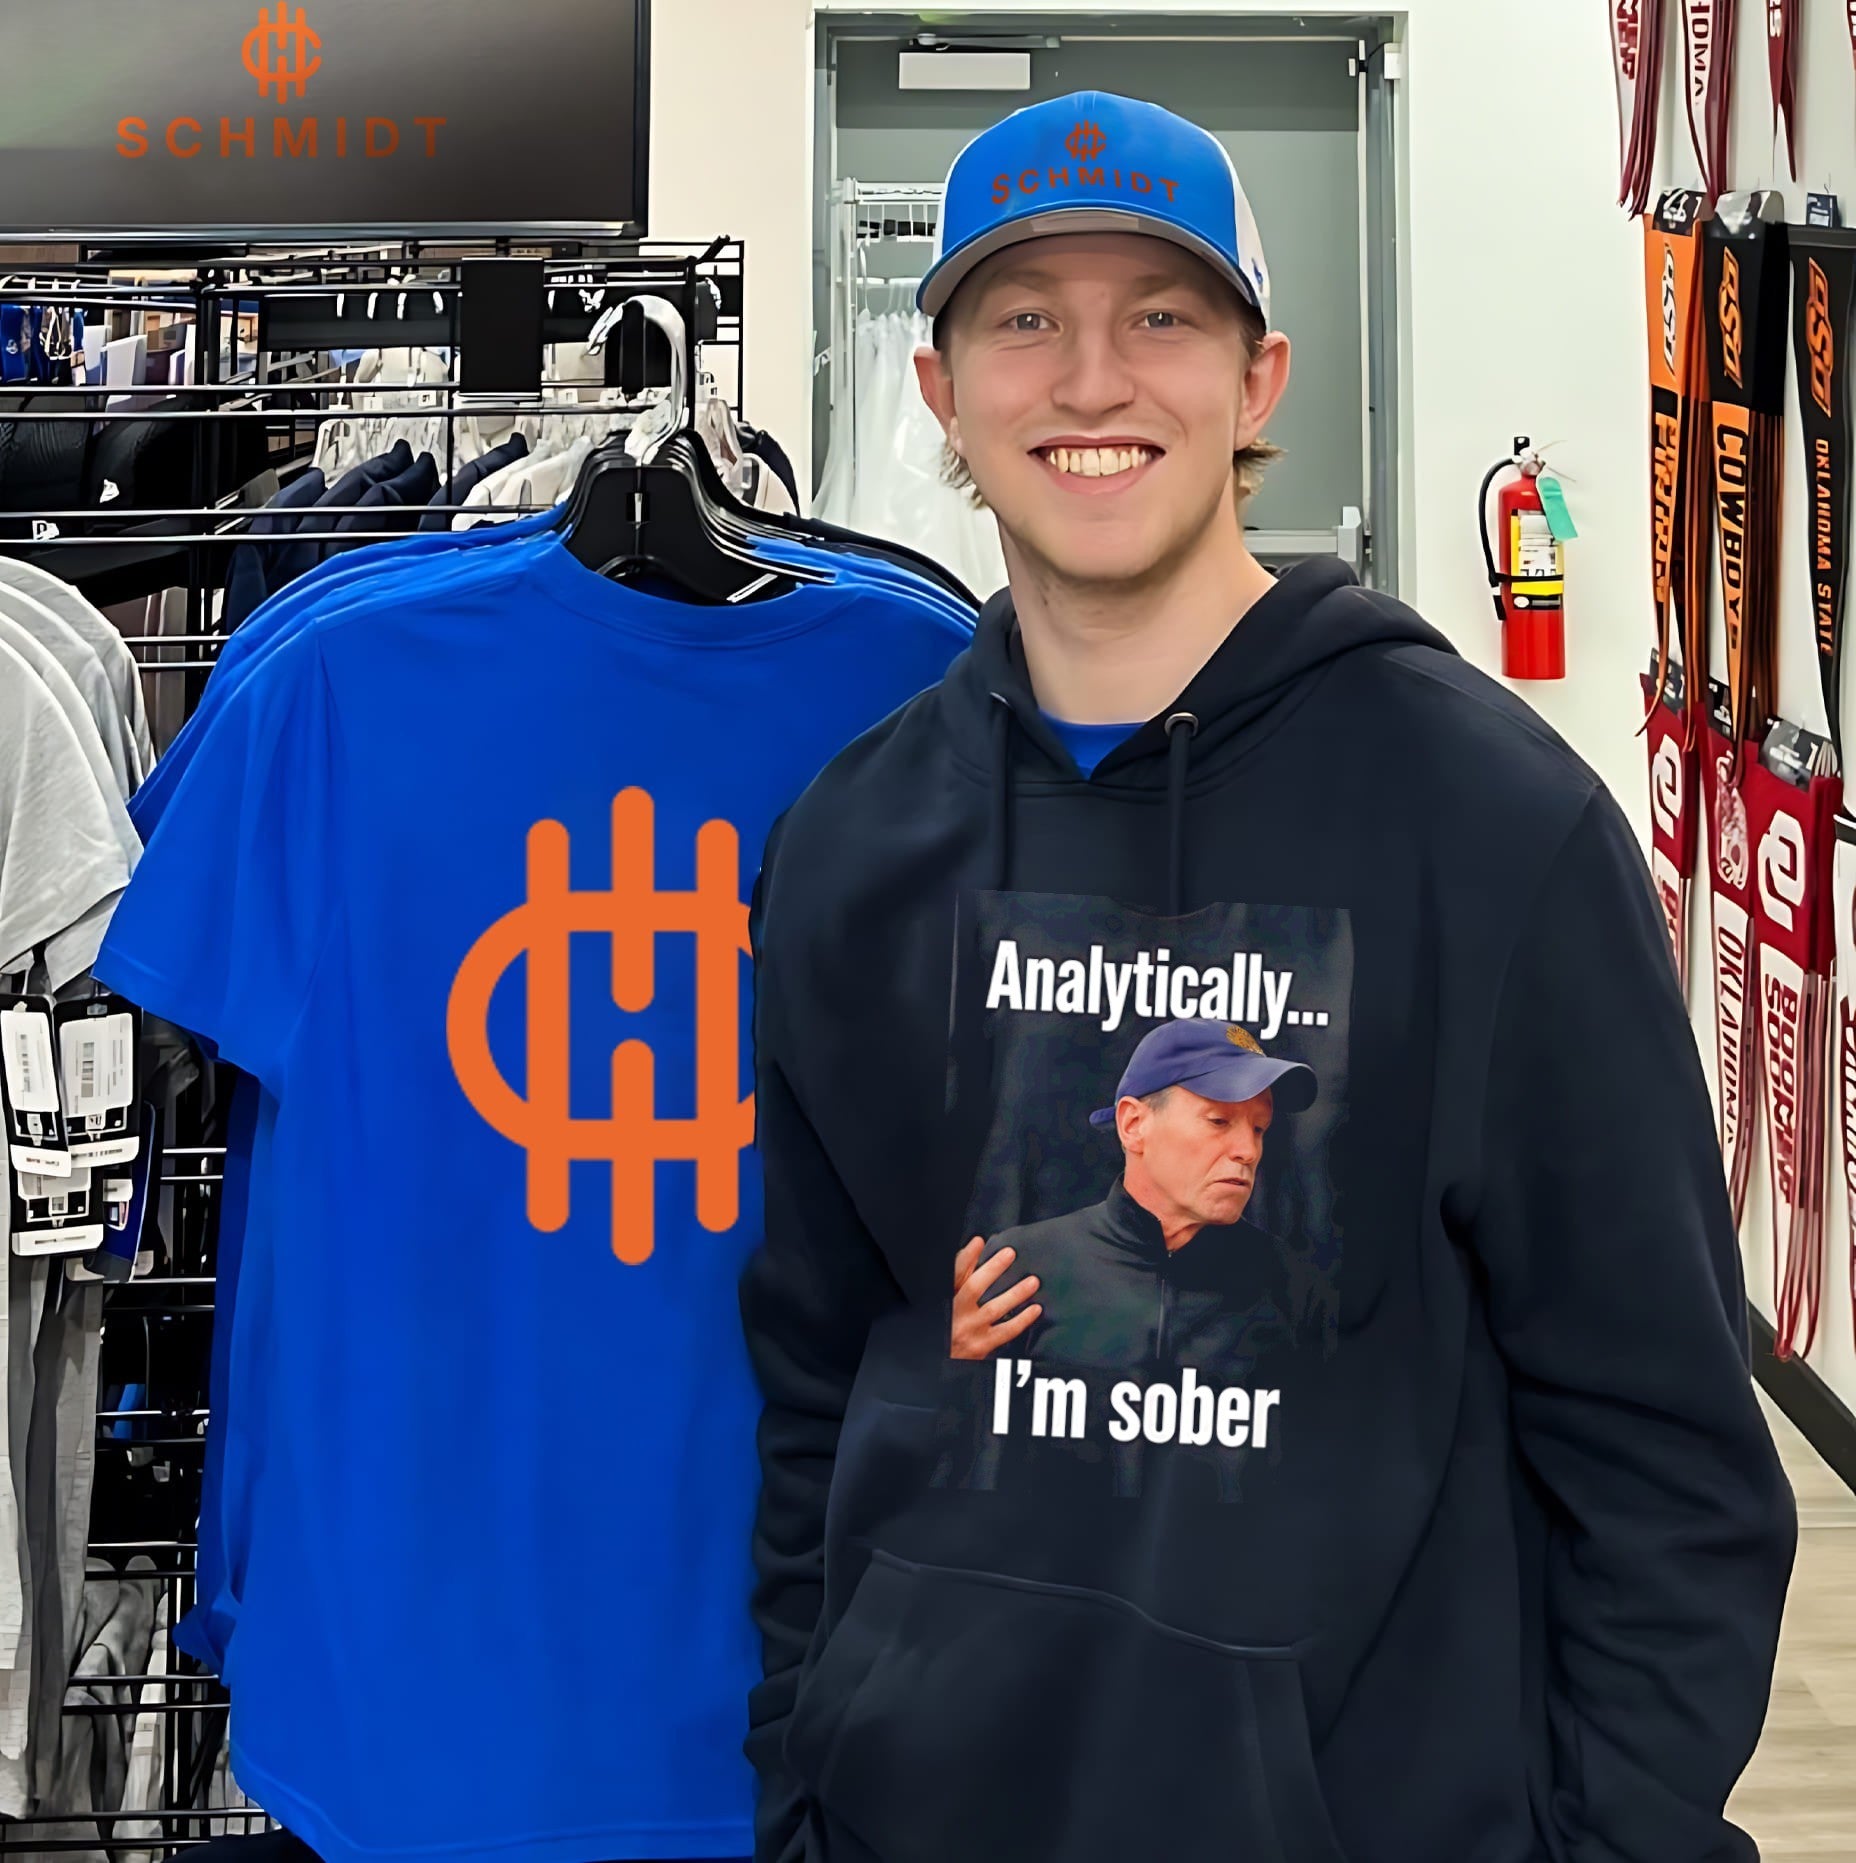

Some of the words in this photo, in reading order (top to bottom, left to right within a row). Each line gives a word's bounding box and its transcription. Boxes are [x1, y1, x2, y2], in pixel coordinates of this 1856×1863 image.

[115, 116, 448, 158] SCHMIDT
[991, 166, 1179, 204] SCHMIDT
[1815, 438, 1832, 571] OKLAHOMA
[986, 940, 1330, 1040] Analytically...
[1718, 926, 1744, 1144] OKLAHOMA
[1108, 1369, 1281, 1449] sober
